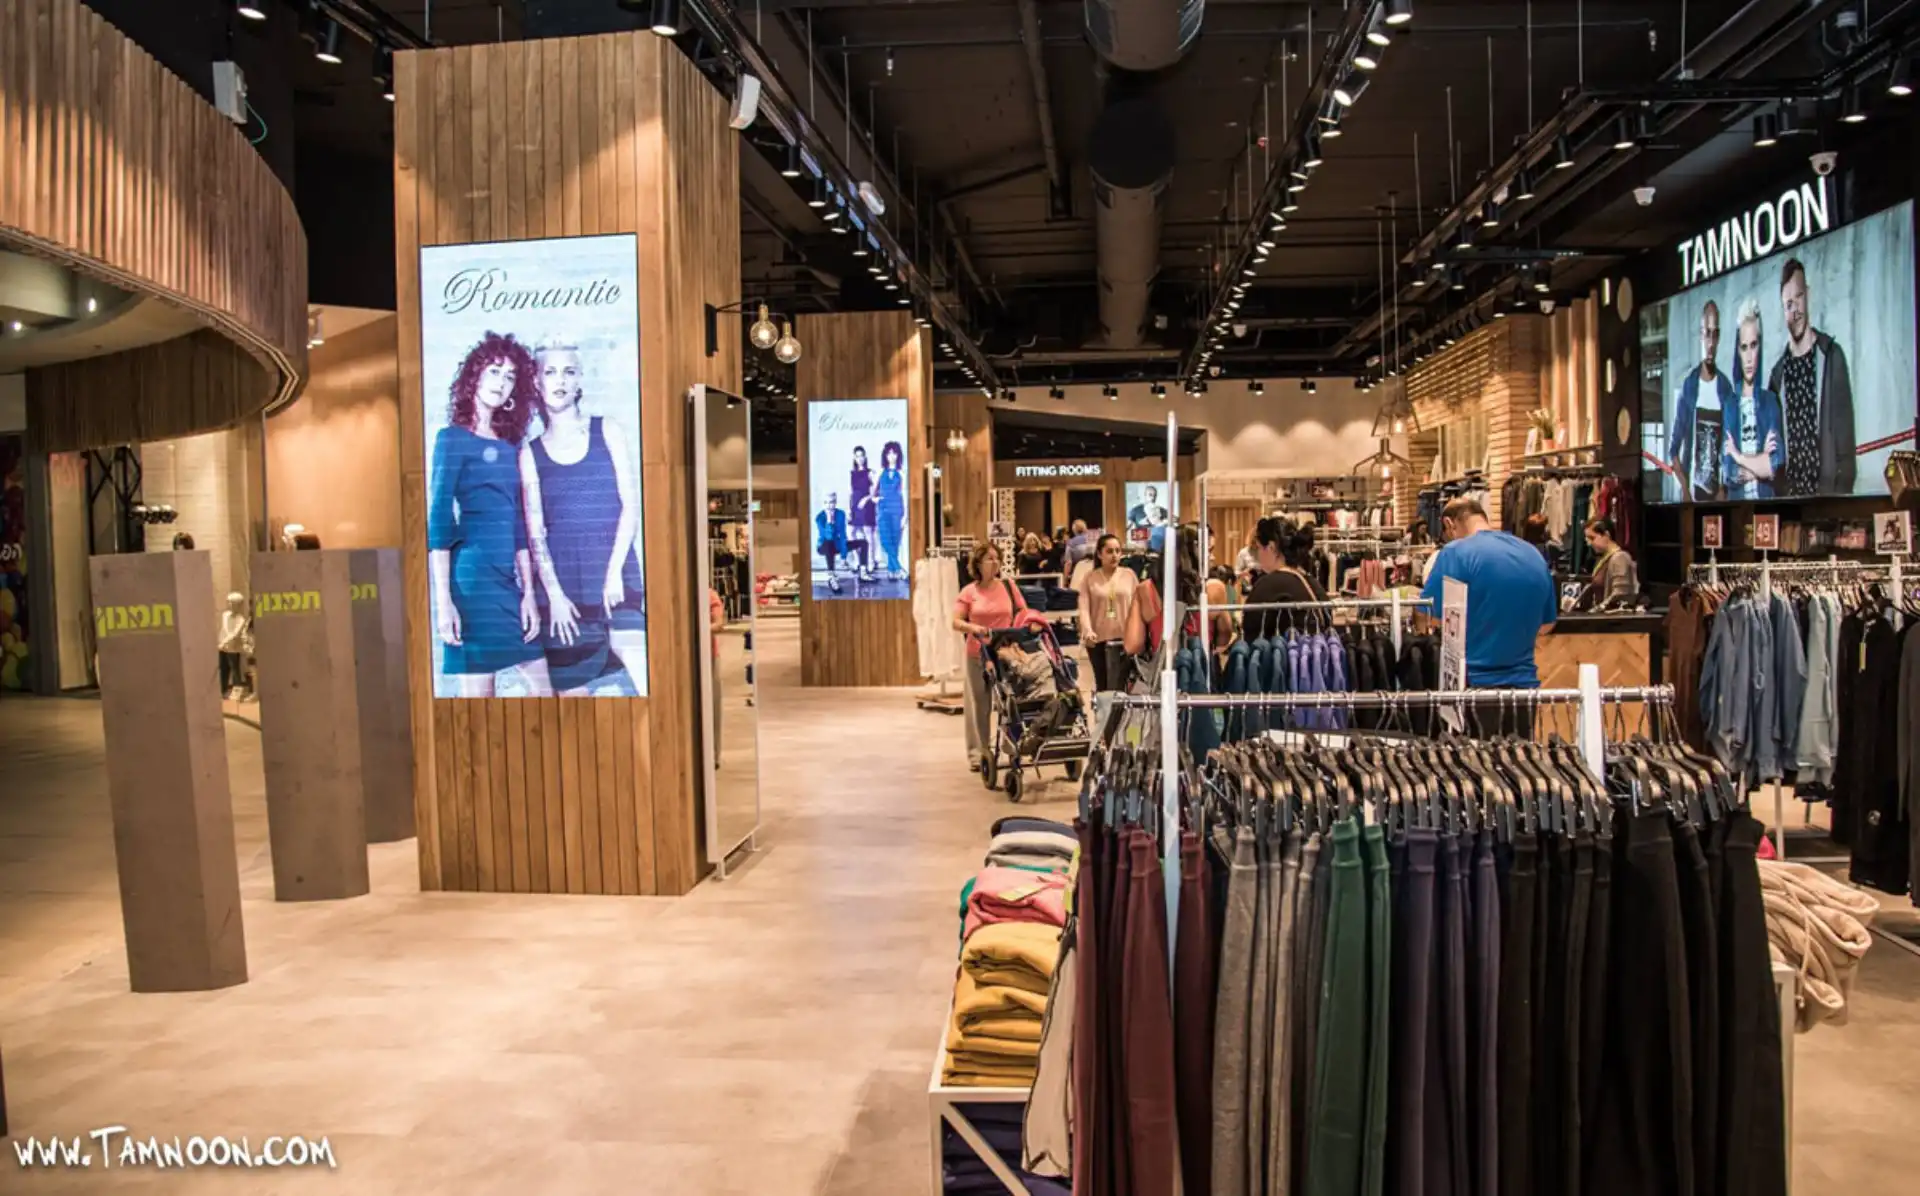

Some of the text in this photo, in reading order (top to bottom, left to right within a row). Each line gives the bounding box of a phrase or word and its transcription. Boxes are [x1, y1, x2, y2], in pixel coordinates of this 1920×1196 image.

[1677, 175, 1829, 286] TAMNOON
[441, 268, 622, 314] Romantic
[1015, 464, 1101, 477] FITTING ROOMS
[255, 590, 321, 617] תמנון
[96, 604, 173, 637] תמנון
